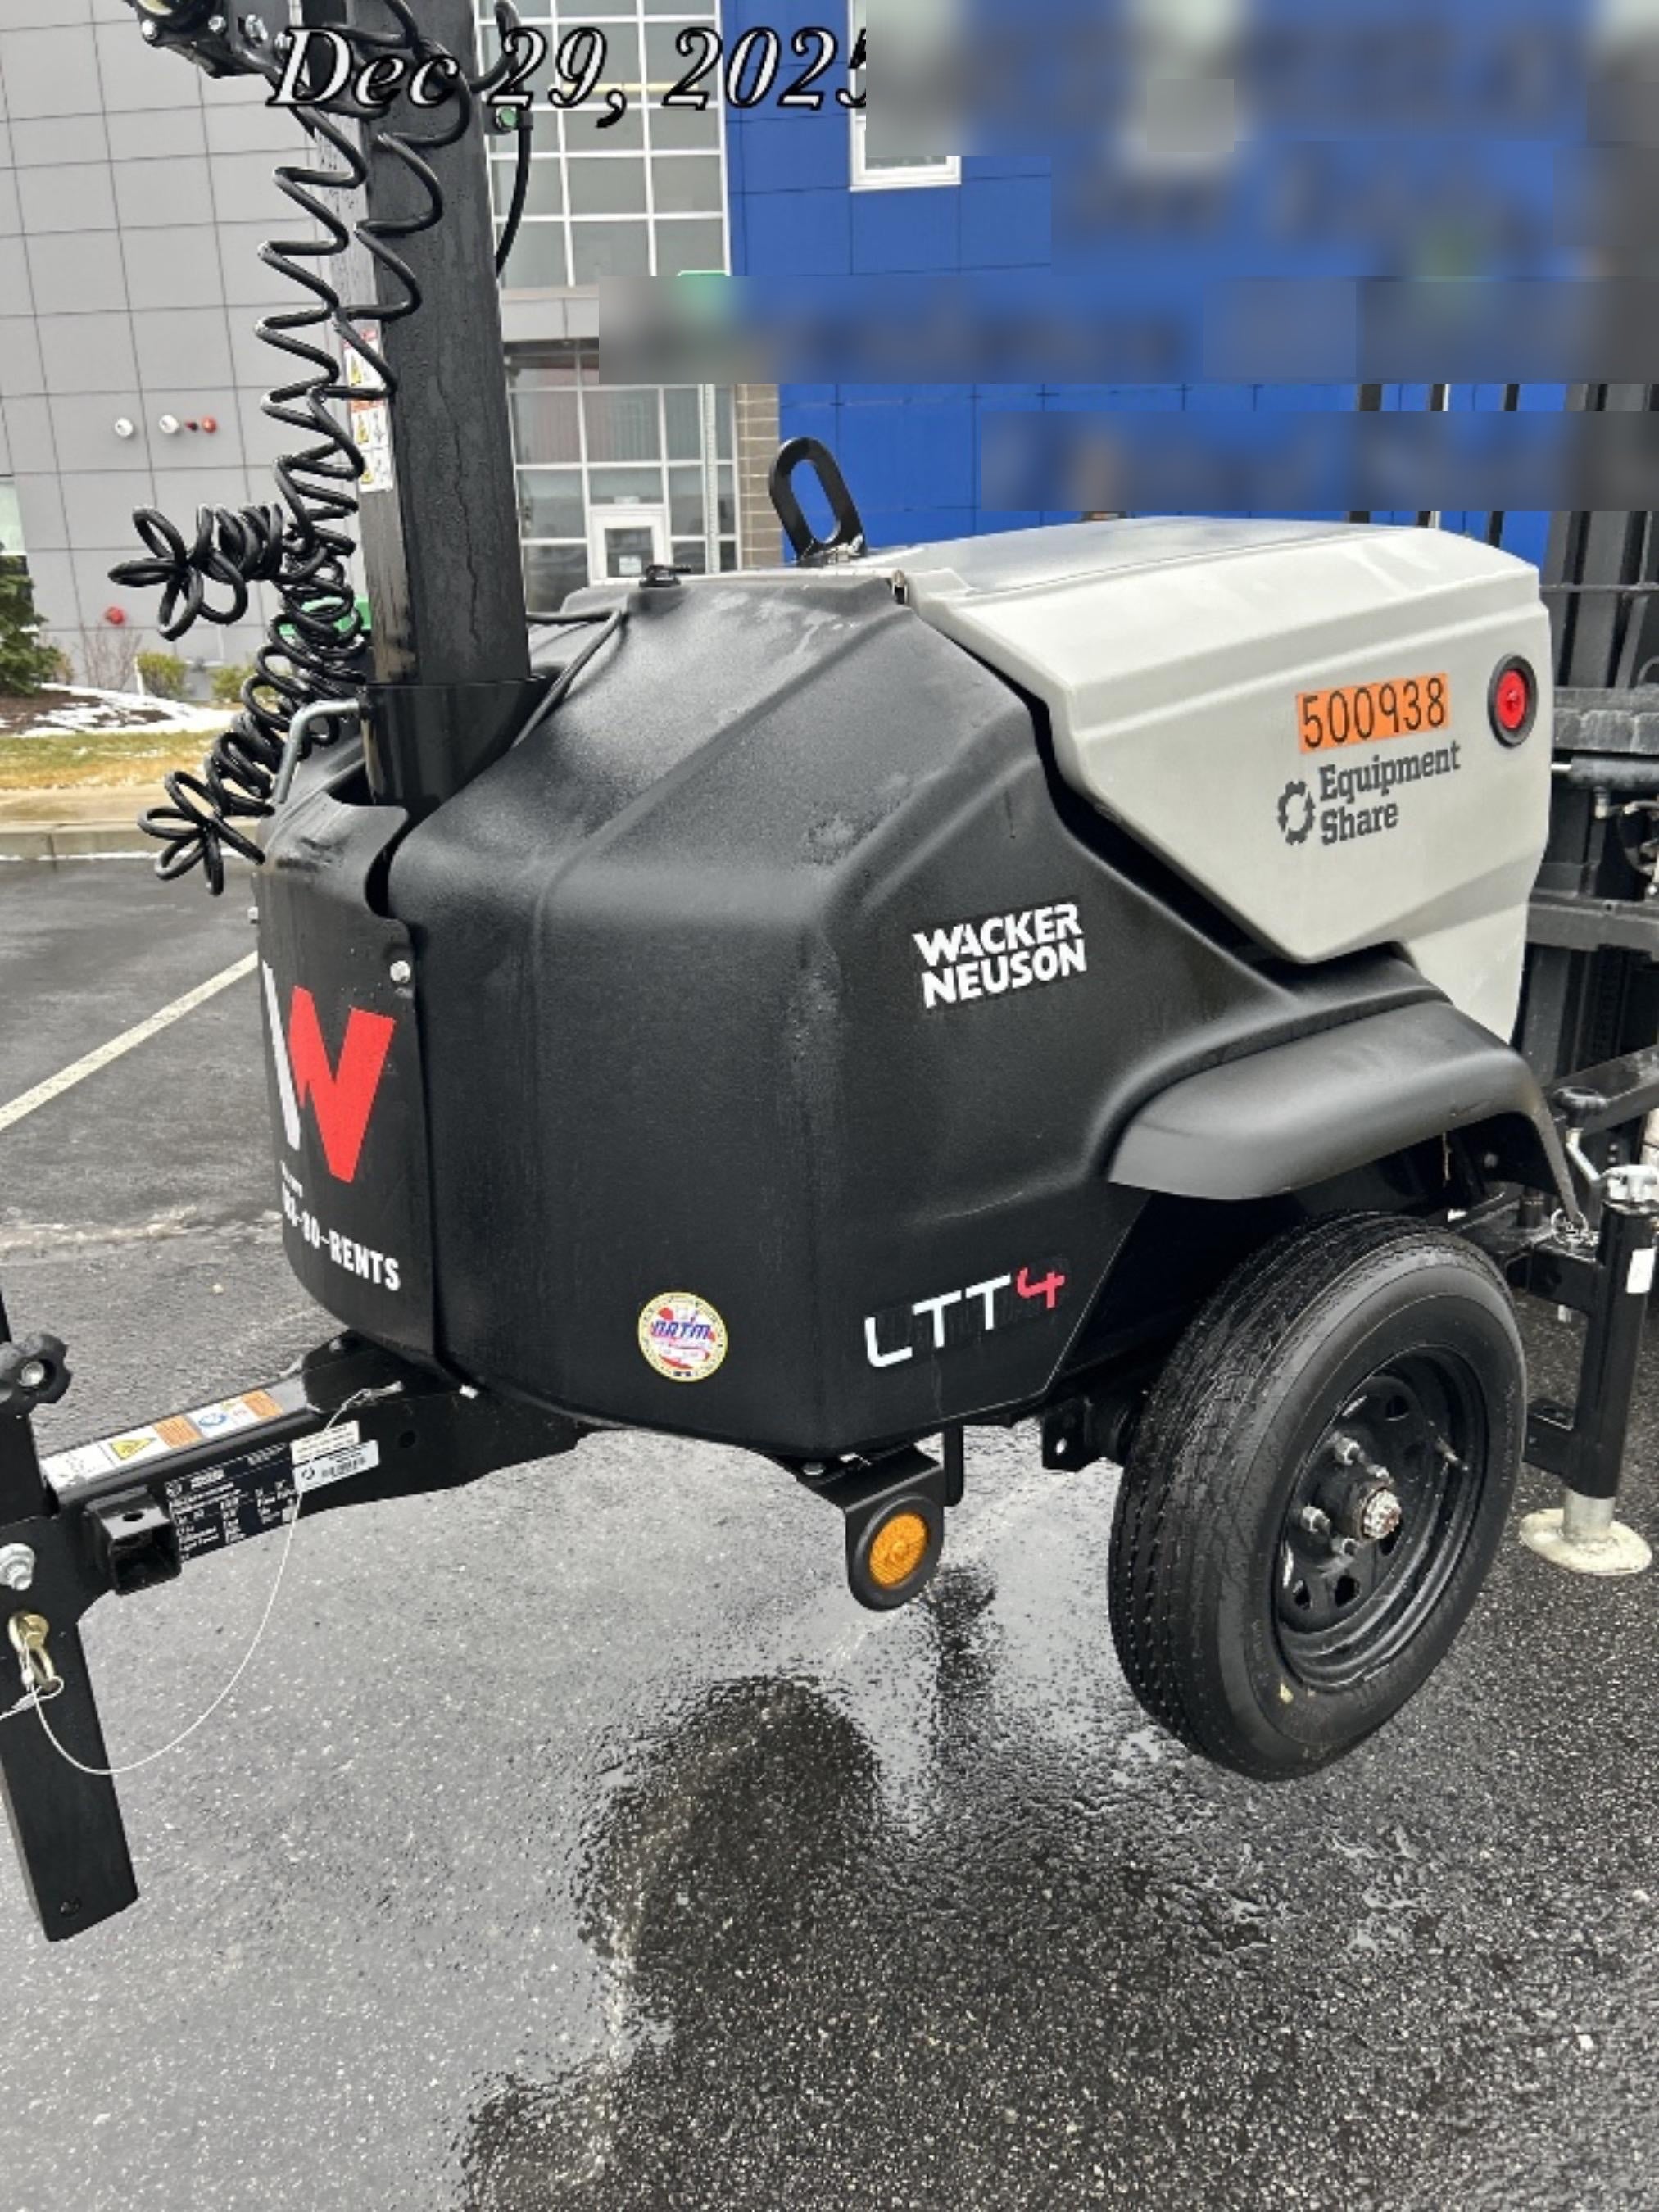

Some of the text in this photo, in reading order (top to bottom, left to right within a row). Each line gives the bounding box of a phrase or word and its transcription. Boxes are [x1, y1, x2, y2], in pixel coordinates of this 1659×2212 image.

[1302, 677, 1445, 749] 500938
[1318, 740, 1461, 805] Equipment
[1321, 802, 1399, 846] Share
[911, 903, 1084, 968] WACKER
[921, 938, 1087, 1009] NEUSON
[864, 1267, 1065, 1367] LTT4
